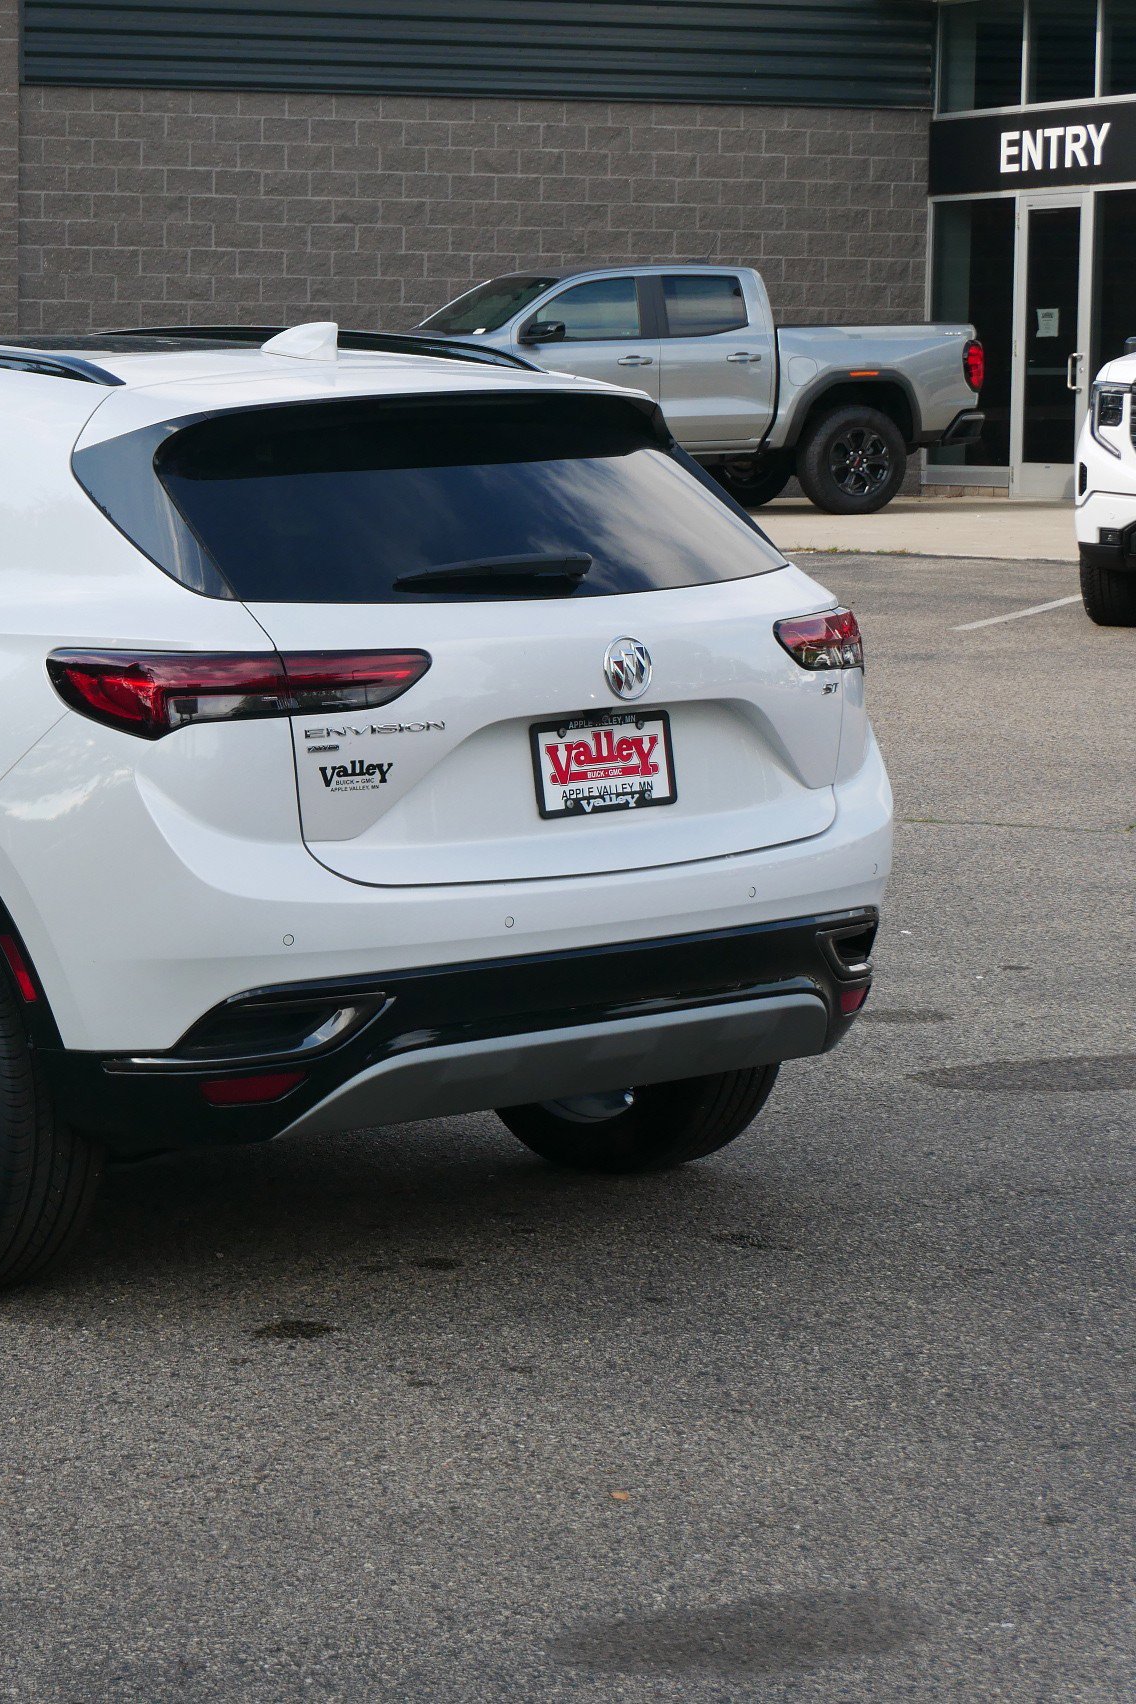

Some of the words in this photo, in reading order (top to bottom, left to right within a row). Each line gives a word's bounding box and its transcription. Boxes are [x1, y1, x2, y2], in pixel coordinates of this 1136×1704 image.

[1000, 122, 1111, 173] ENTRY
[624, 715, 636, 723] MN
[304, 720, 445, 739] ENVISION
[587, 770, 605, 778] BUICK
[638, 780, 654, 791] MN
